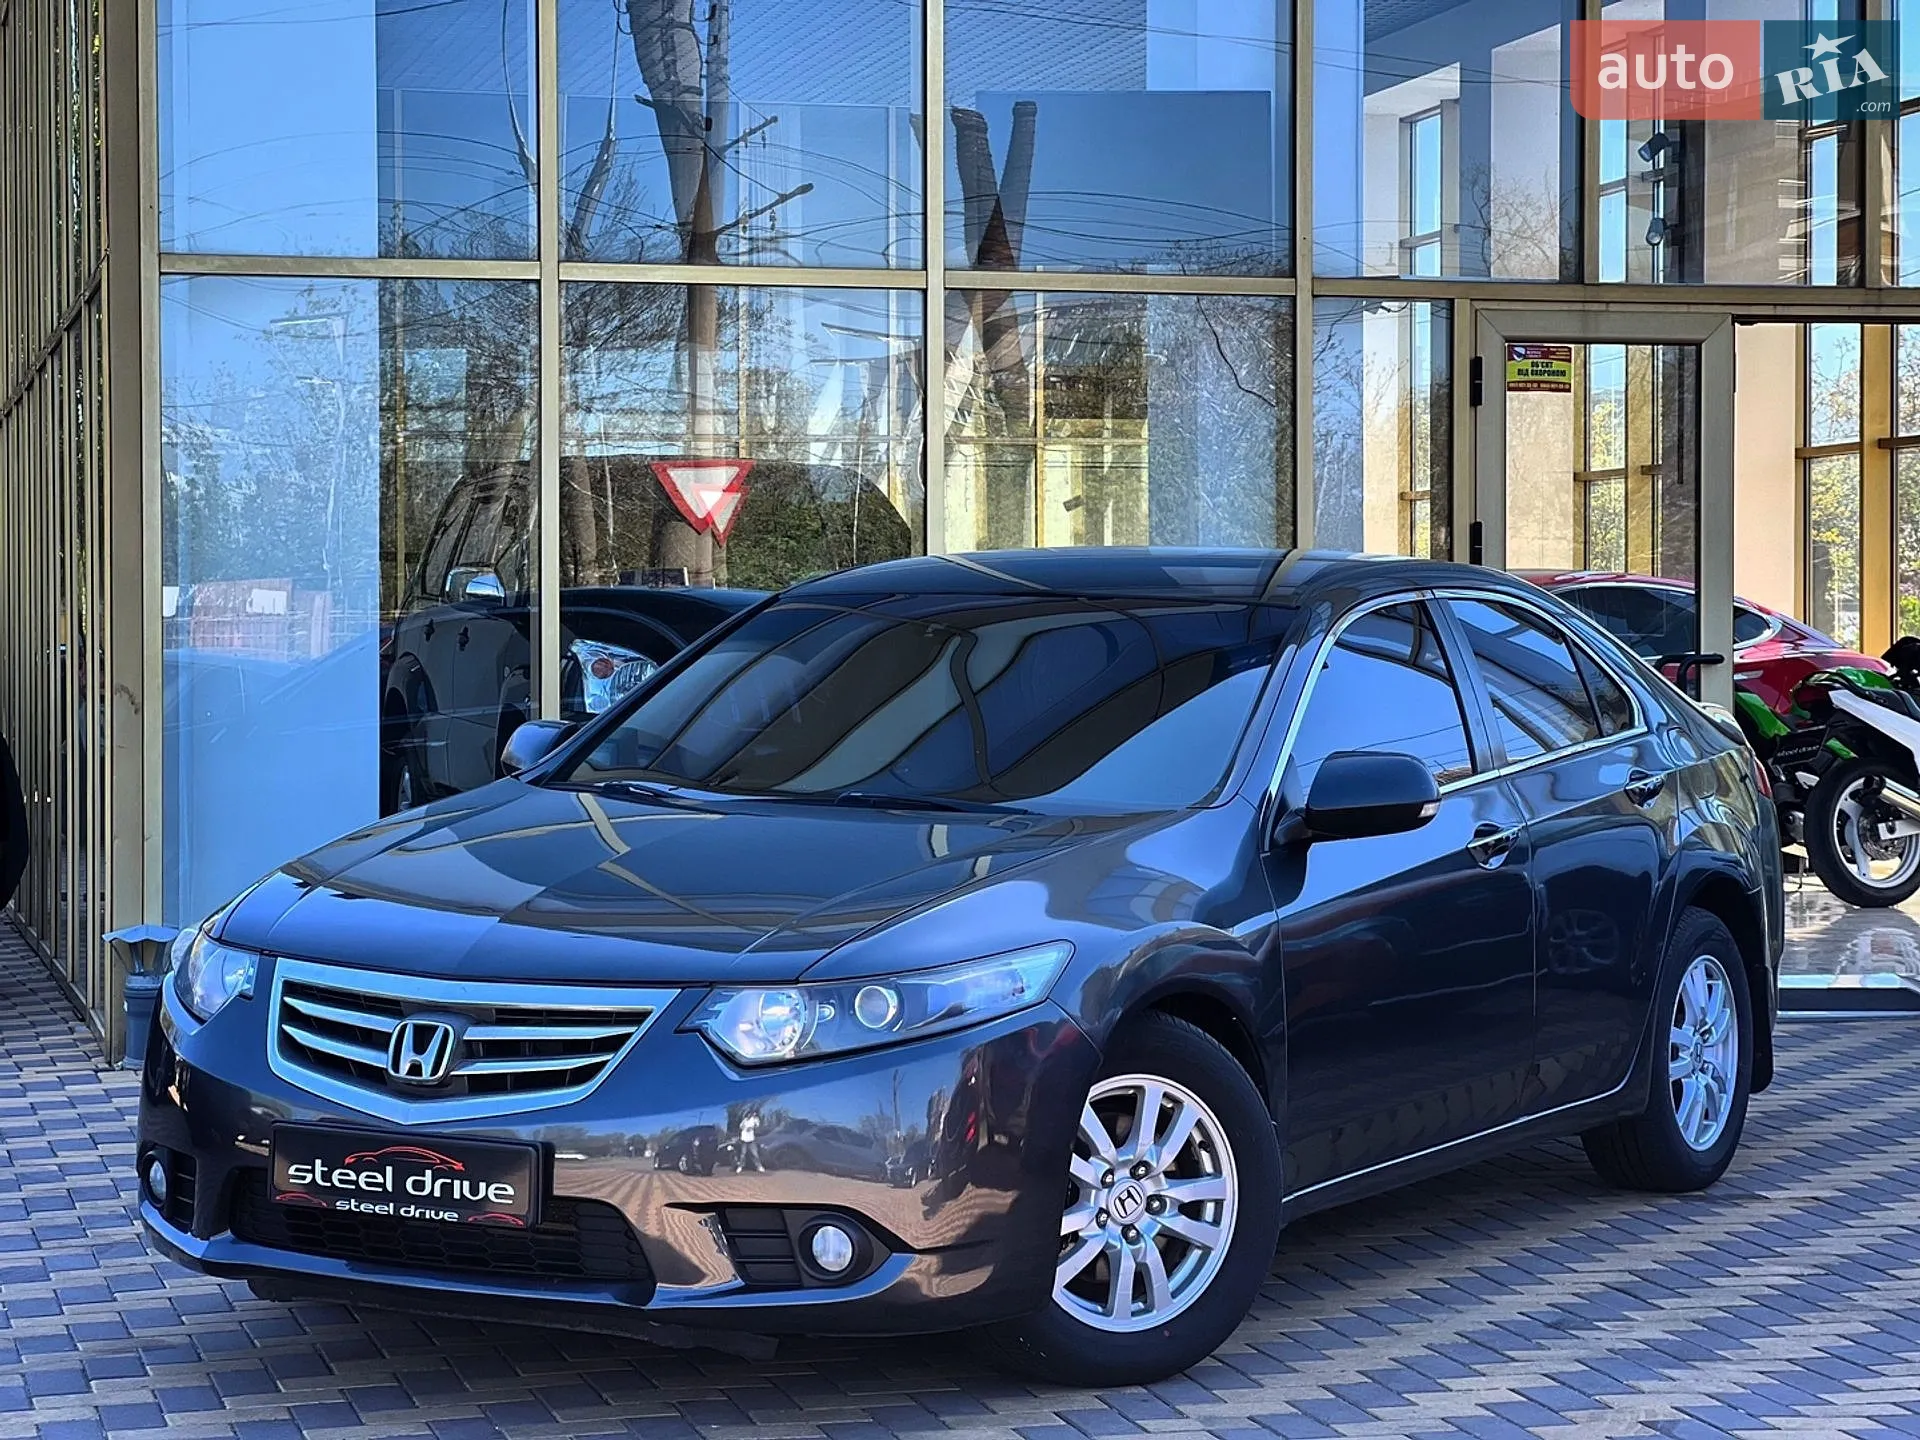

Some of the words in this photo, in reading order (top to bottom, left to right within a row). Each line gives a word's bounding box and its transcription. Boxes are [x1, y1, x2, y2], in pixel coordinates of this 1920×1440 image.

[287, 1158, 393, 1193] steel
[405, 1169, 515, 1204] drive
[335, 1198, 394, 1216] steel
[399, 1204, 459, 1222] drive
